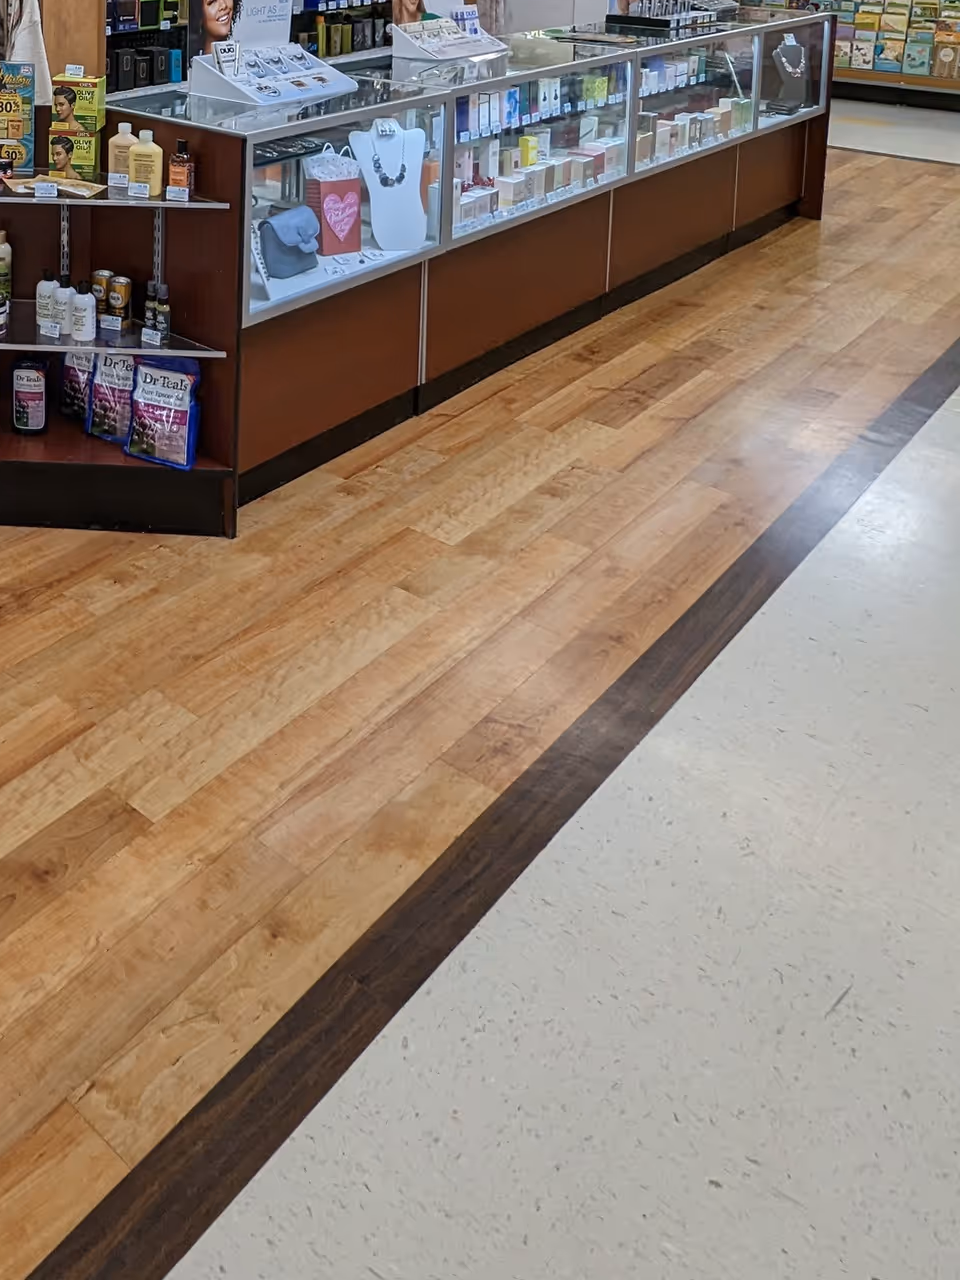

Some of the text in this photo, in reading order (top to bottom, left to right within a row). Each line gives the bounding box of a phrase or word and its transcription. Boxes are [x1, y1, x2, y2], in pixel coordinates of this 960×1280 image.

[246, 5, 277, 16] LIGHT AS
[104, 356, 134, 371] Dr Tea
[143, 372, 189, 392] Dr Teal's
